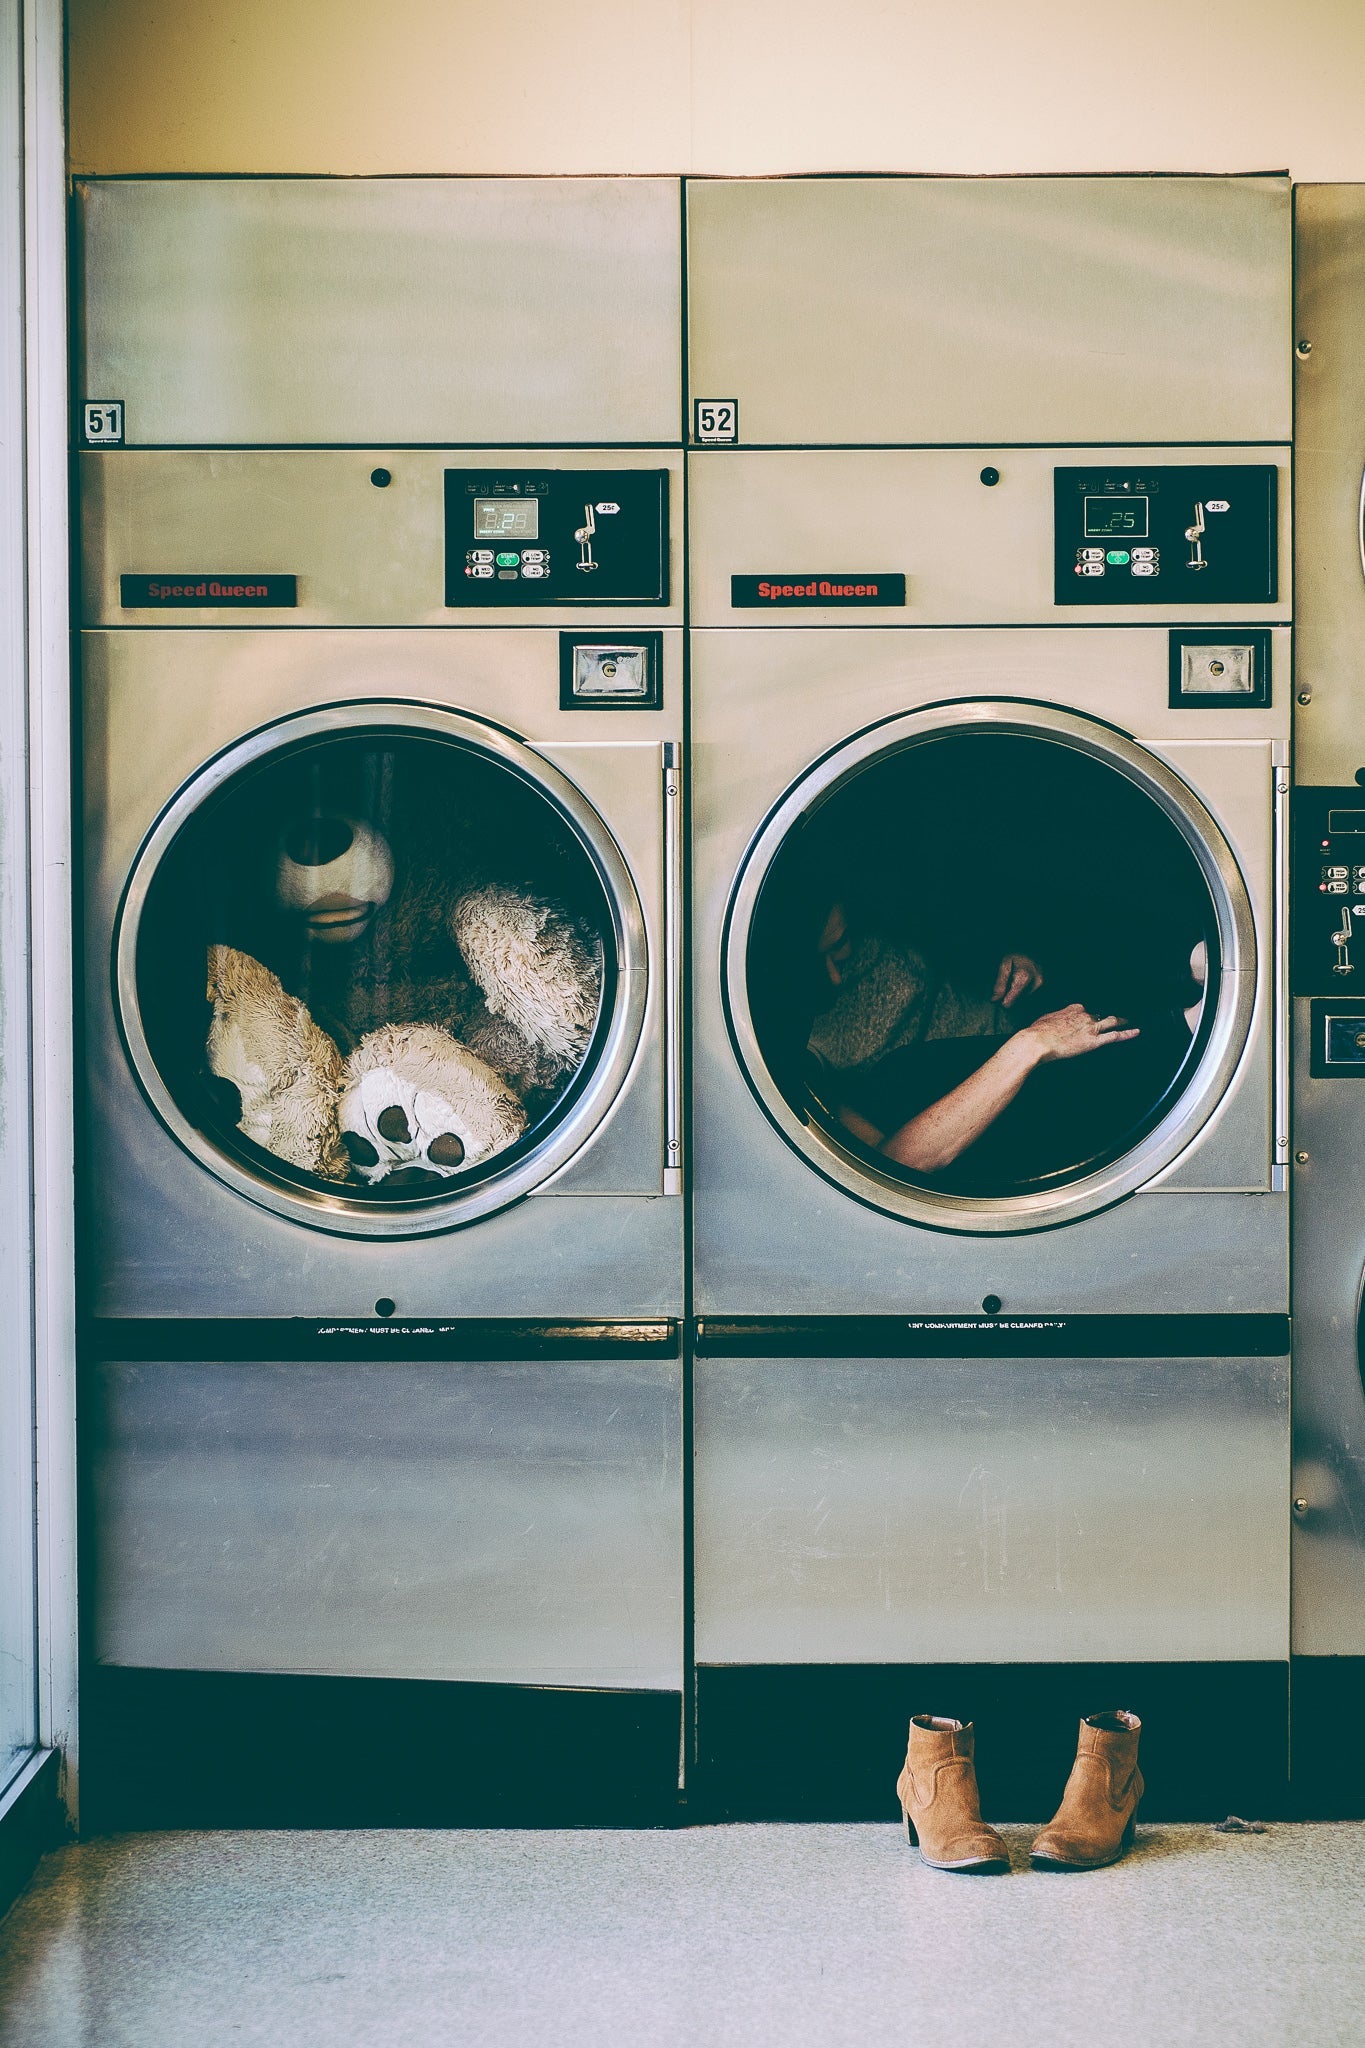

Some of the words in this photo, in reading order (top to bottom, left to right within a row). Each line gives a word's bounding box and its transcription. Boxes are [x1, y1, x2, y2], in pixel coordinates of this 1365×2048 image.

[90, 410, 117, 433] 51
[702, 408, 731, 431] 52
[148, 583, 206, 599] Speed
[209, 583, 268, 596] Queen
[758, 582, 816, 599] Speed
[819, 582, 878, 596] Queen
